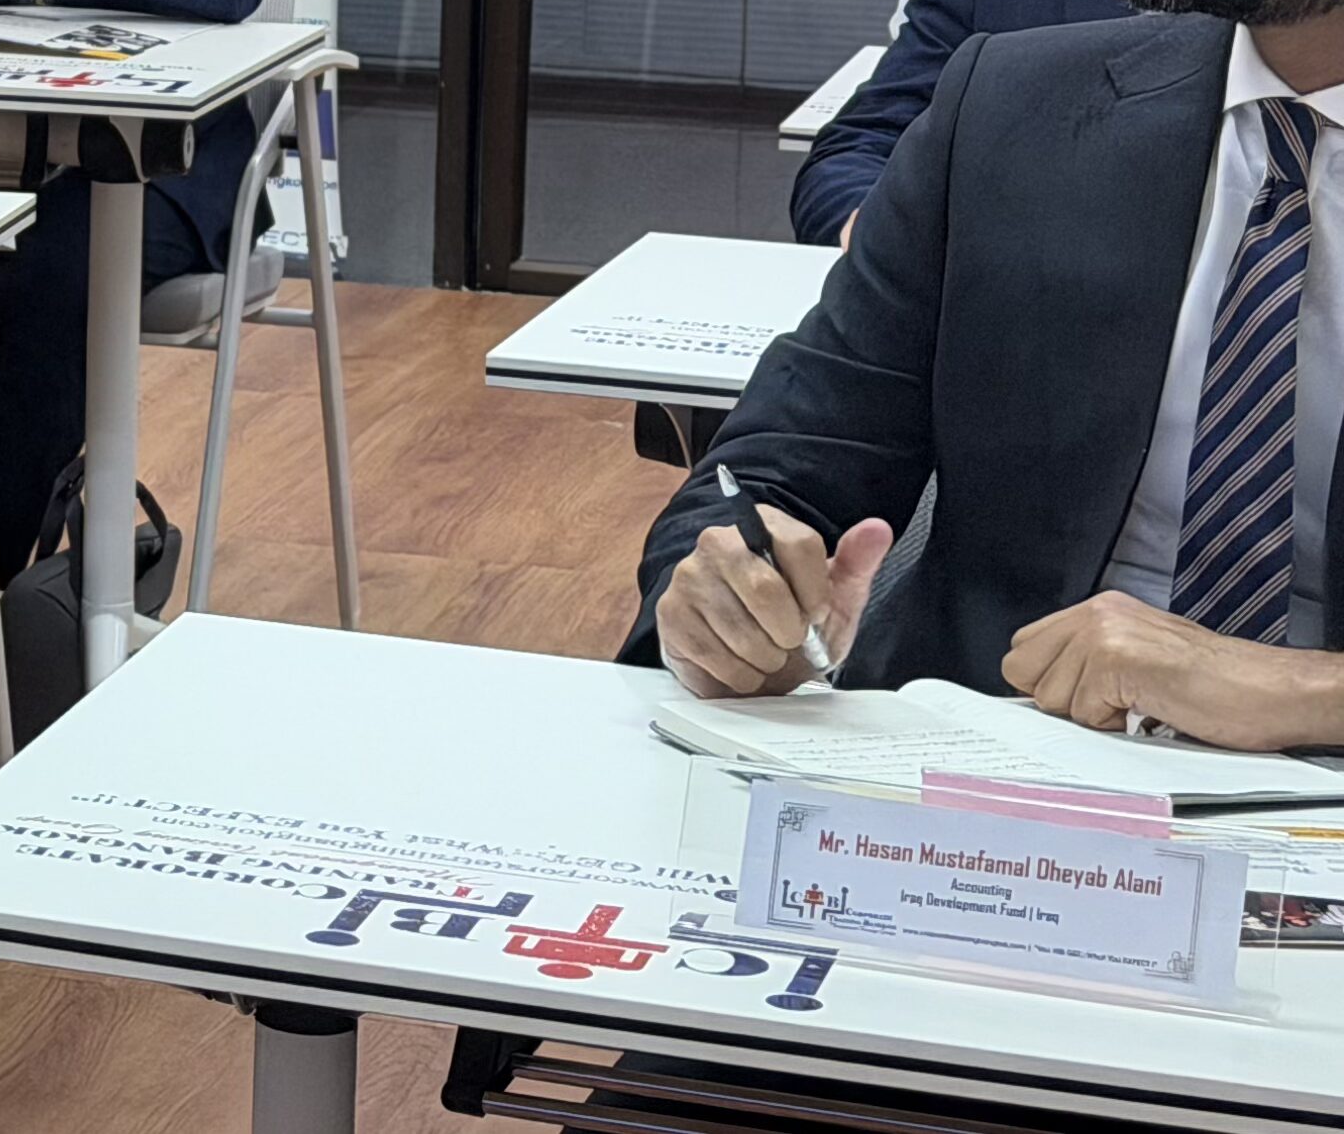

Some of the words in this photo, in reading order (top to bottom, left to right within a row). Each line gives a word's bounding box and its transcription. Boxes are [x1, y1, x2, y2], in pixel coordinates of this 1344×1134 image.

[1, 824, 228, 866] BANGKOK
[819, 829, 849, 855] Mr.
[855, 834, 914, 863] Hasan
[919, 842, 1031, 878] Mustafamal
[1036, 858, 1108, 890] Dheyab
[1113, 868, 1163, 896] Alani
[16, 844, 347, 899] CORPORATE
[241, 856, 485, 900] TRAINING
[951, 877, 1012, 900] Accounting
[901, 889, 923, 907] Iraq
[926, 892, 997, 915] Development
[1000, 902, 1027, 919] Fund
[1036, 907, 1060, 925] Iraq
